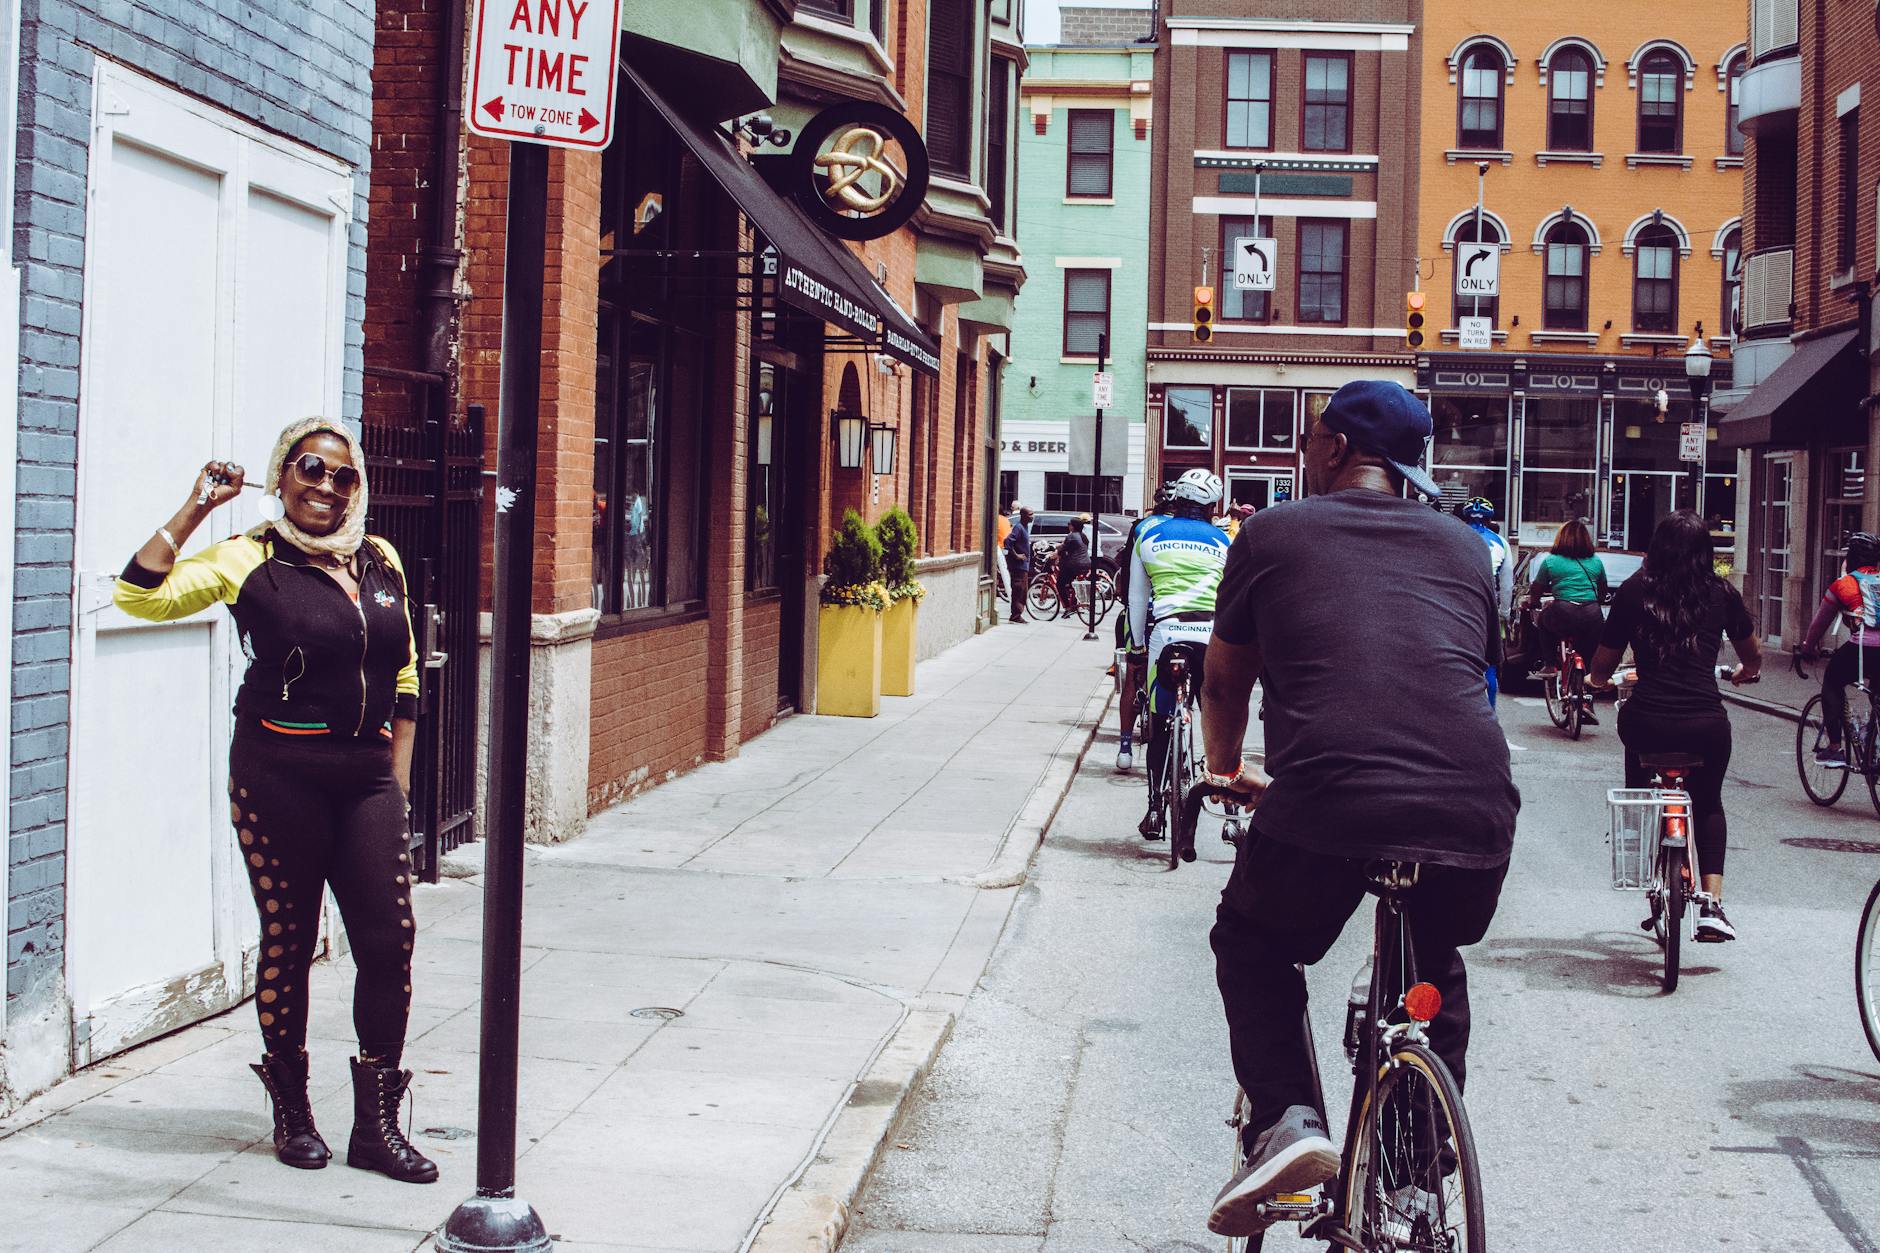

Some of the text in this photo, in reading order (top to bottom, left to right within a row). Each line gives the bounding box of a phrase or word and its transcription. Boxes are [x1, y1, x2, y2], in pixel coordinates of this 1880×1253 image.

[509, 0, 589, 40] ANY
[503, 44, 589, 96] TIME
[510, 103, 573, 126] TOW ZONE
[1238, 273, 1272, 284] ONLY
[1461, 278, 1495, 290] ONLY
[785, 266, 877, 332] AUTHENTIC HAND-ROLLED
[1012, 440, 1022, 452] &
[1028, 440, 1067, 453] BEER
